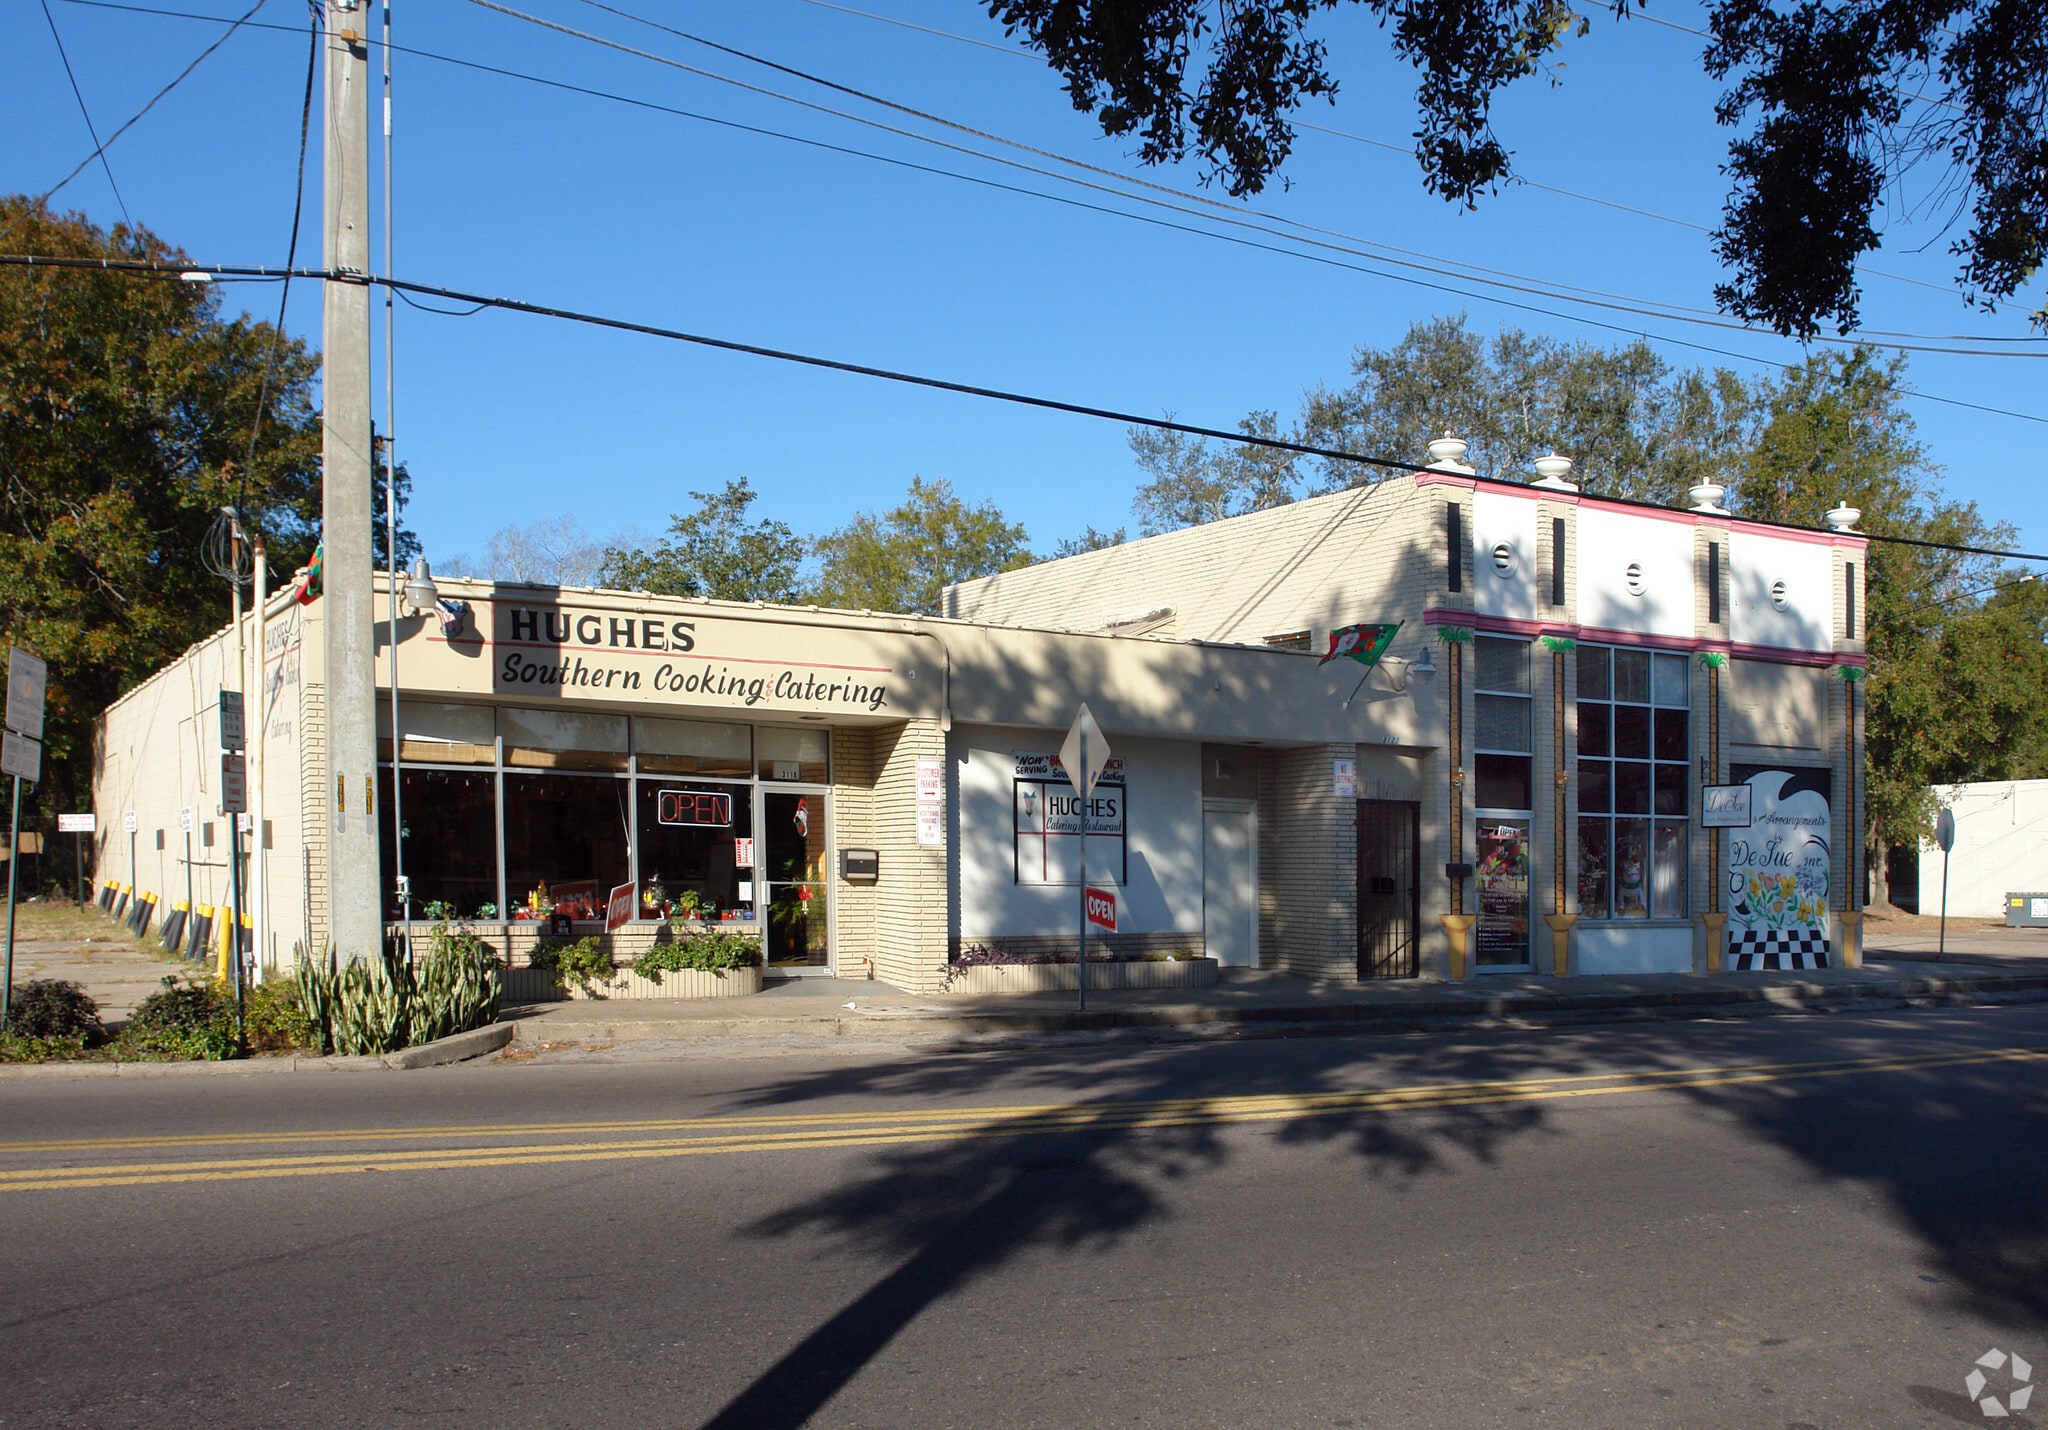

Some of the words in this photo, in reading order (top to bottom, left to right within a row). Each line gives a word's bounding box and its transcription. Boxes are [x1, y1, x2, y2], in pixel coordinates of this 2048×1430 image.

[510, 609, 696, 652] HUGHES
[502, 653, 641, 690] Southern
[653, 663, 766, 706] Cooking
[774, 671, 888, 711] Catering
[918, 768, 940, 778] CUSTOMER
[1015, 765, 1048, 775] SERVING
[920, 779, 939, 788] PARKING
[661, 793, 729, 824] OPEN
[1046, 817, 1079, 832] Catering
[1765, 811, 1827, 830] Arrangements
[1088, 895, 1114, 922] OPEN
